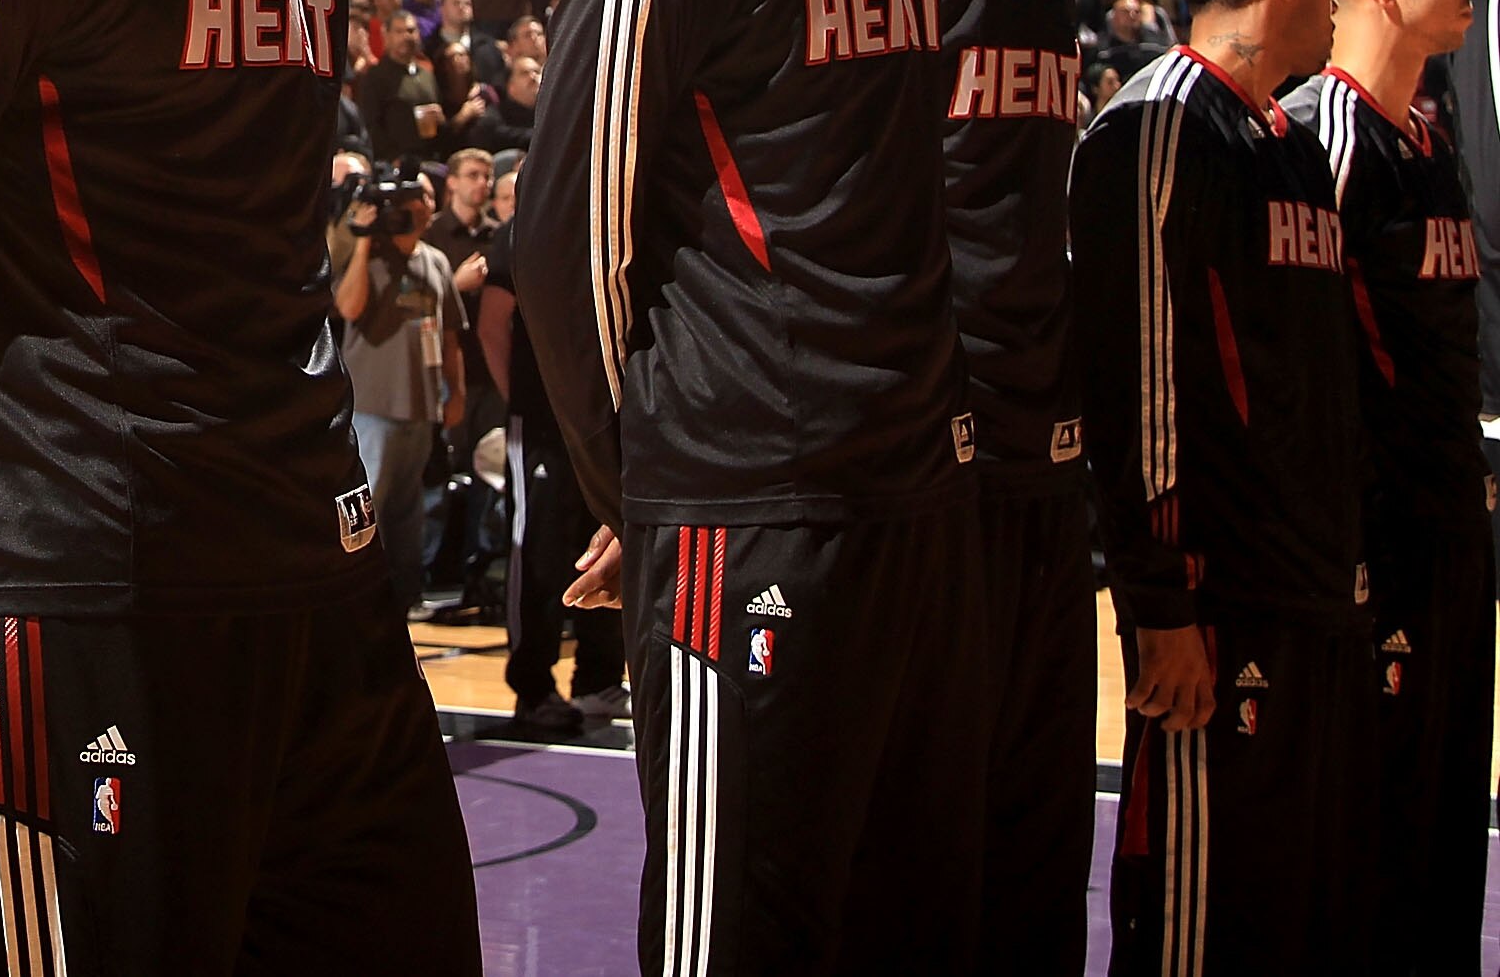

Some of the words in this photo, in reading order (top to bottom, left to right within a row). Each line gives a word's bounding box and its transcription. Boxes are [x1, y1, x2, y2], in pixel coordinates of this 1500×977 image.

[948, 38, 1082, 123] HEAT
[746, 603, 793, 619] adidas
[79, 749, 136, 765] adidas
[93, 822, 111, 832] NBA
